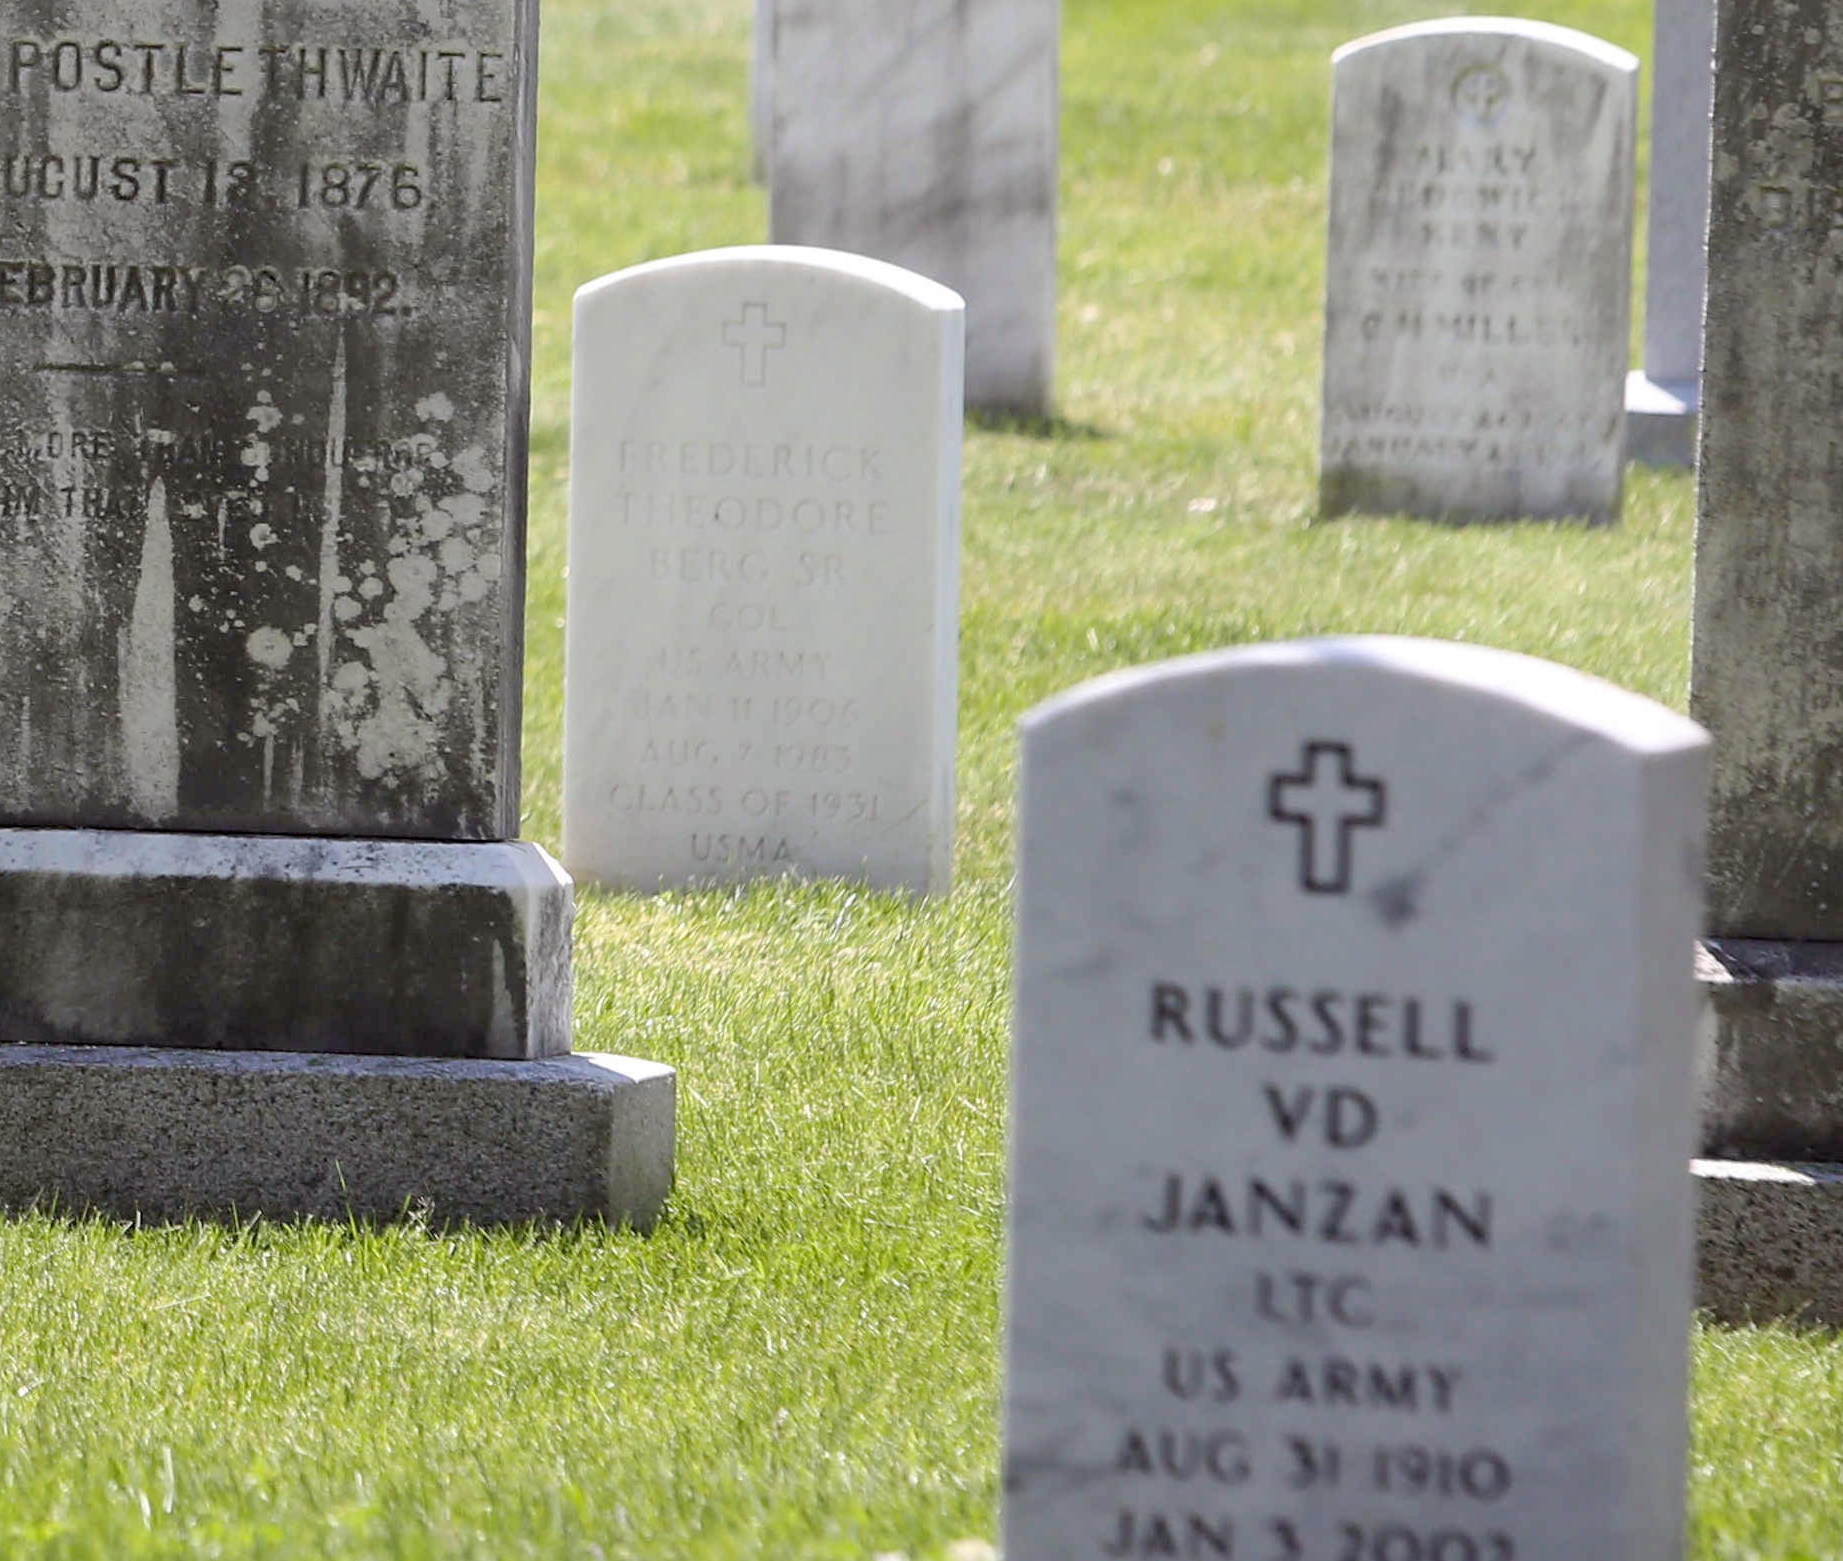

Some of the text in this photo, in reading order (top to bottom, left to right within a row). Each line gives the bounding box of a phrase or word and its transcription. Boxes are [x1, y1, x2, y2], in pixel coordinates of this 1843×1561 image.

[8, 37, 504, 103] POSTLETHWAITE
[617, 440, 884, 481] FREDERICK
[620, 490, 891, 535] THEODORE
[609, 784, 724, 816] CLASS
[740, 788, 790, 817] OF
[690, 833, 794, 862] USMA
[1149, 979, 1496, 1064] RUSSELL
[1262, 1082, 1381, 1149] VD
[1143, 1172, 1493, 1249] JANZAN
[1254, 1270, 1376, 1328] LTC
[1162, 1348, 1463, 1414] US ARMY
[1116, 1427, 1514, 1502] AUG 31 1910
[1102, 1510, 1234, 1560] JAN
